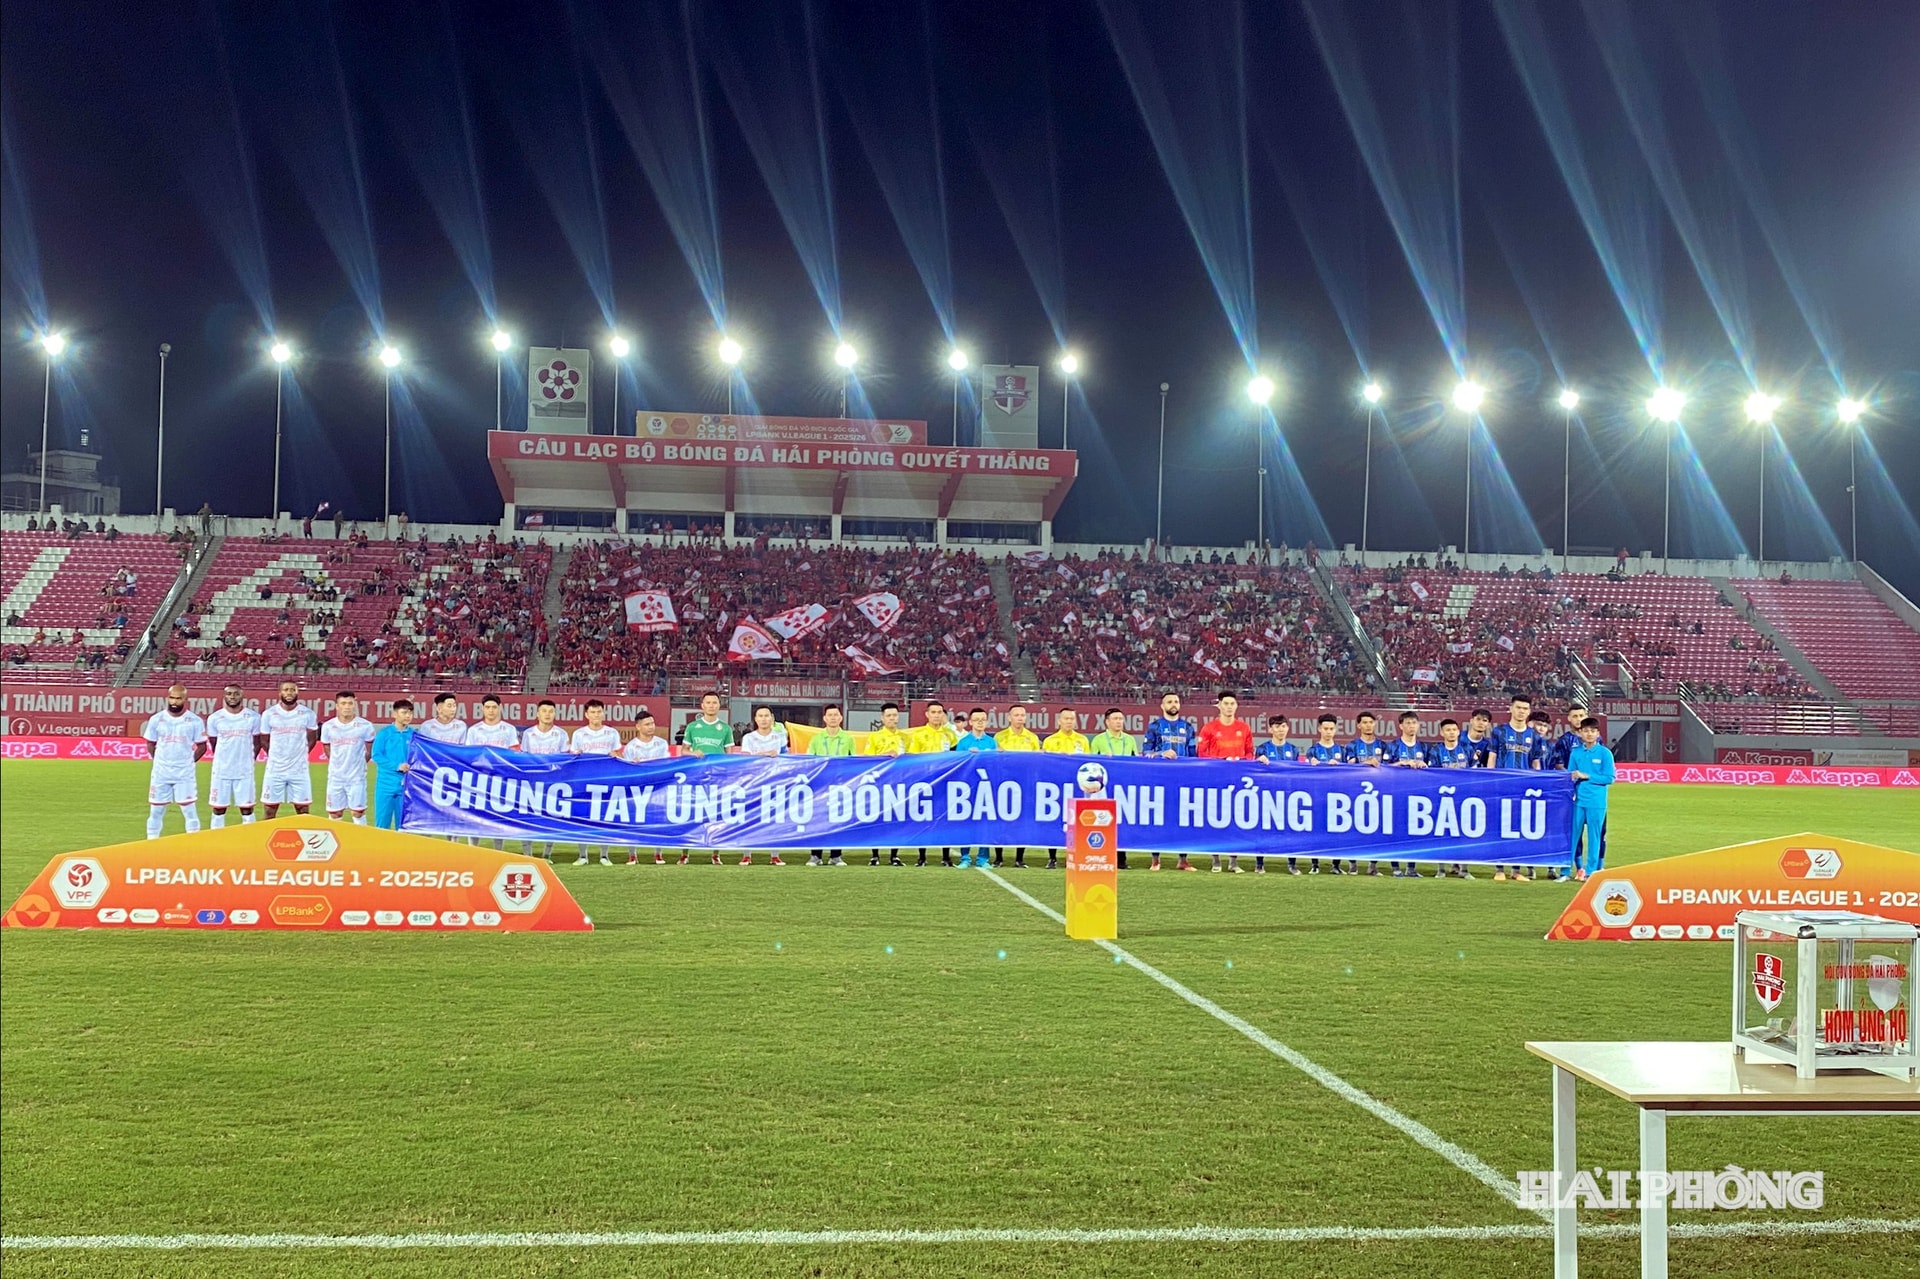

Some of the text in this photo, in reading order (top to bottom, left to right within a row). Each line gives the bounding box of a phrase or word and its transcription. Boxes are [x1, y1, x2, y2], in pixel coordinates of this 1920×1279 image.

[783, 432, 822, 441] V.LEAGUE
[833, 434, 867, 442] 2025/26
[519, 438, 1049, 471] CÂU LẠC BỘ BÓNG ĐÁ HẢI PHÒNG QUYẾT THẮNG
[769, 683, 790, 697] BÓNG
[791, 683, 801, 696] ĐÁ
[802, 683, 815, 697] HẢI
[816, 683, 841, 698] PHÒNG
[13, 690, 73, 713] THÀNH
[78, 690, 116, 713] PHỐ
[121, 696, 169, 714] CHUN
[187, 698, 218, 714] TAY
[375, 695, 426, 719] TRN
[473, 703, 521, 721] BNG
[602, 702, 648, 722] HÒNG
[1612, 700, 1631, 714] BÓNG
[1632, 701, 1642, 714] ĐÁ
[1642, 700, 1654, 714] HẢI
[1655, 701, 1678, 715] PHÒNG
[37, 723, 124, 736] V.League.VPF
[988, 706, 1009, 729] ẦU
[1025, 707, 1049, 729] HỦ
[1095, 713, 1144, 731] XNG
[1288, 718, 1317, 735] TIN
[1336, 716, 1356, 735] ÊU
[1376, 714, 1397, 736] ỦA
[1, 741, 57, 758] ppa
[101, 740, 152, 759] Kap
[1745, 752, 1807, 765] Kappa
[1616, 763, 1670, 784] appa
[1706, 768, 1775, 785] Kappa
[1811, 769, 1880, 786] Kappa
[431, 767, 1547, 840] CHUNG TAY ỦNG HỘ ĐỒNG BÀO BỊ NH HƯỞNG BỞI BÃO LŨ
[1078, 863, 1114, 872] TOGETHER
[125, 868, 223, 886] LPBANK
[230, 868, 344, 886] V.LEAGUE
[349, 871, 362, 886] 1
[379, 871, 474, 888] 2025/26
[67, 891, 92, 900] VPF
[1656, 889, 1743, 904] LPBANK
[1747, 889, 1848, 906] V.LEAGUE
[1852, 891, 1864, 906] 1
[1879, 891, 1920, 907] 202
[276, 905, 314, 916] LPBank
[1825, 998, 1907, 1047] HÒM ỦNG HỘ
